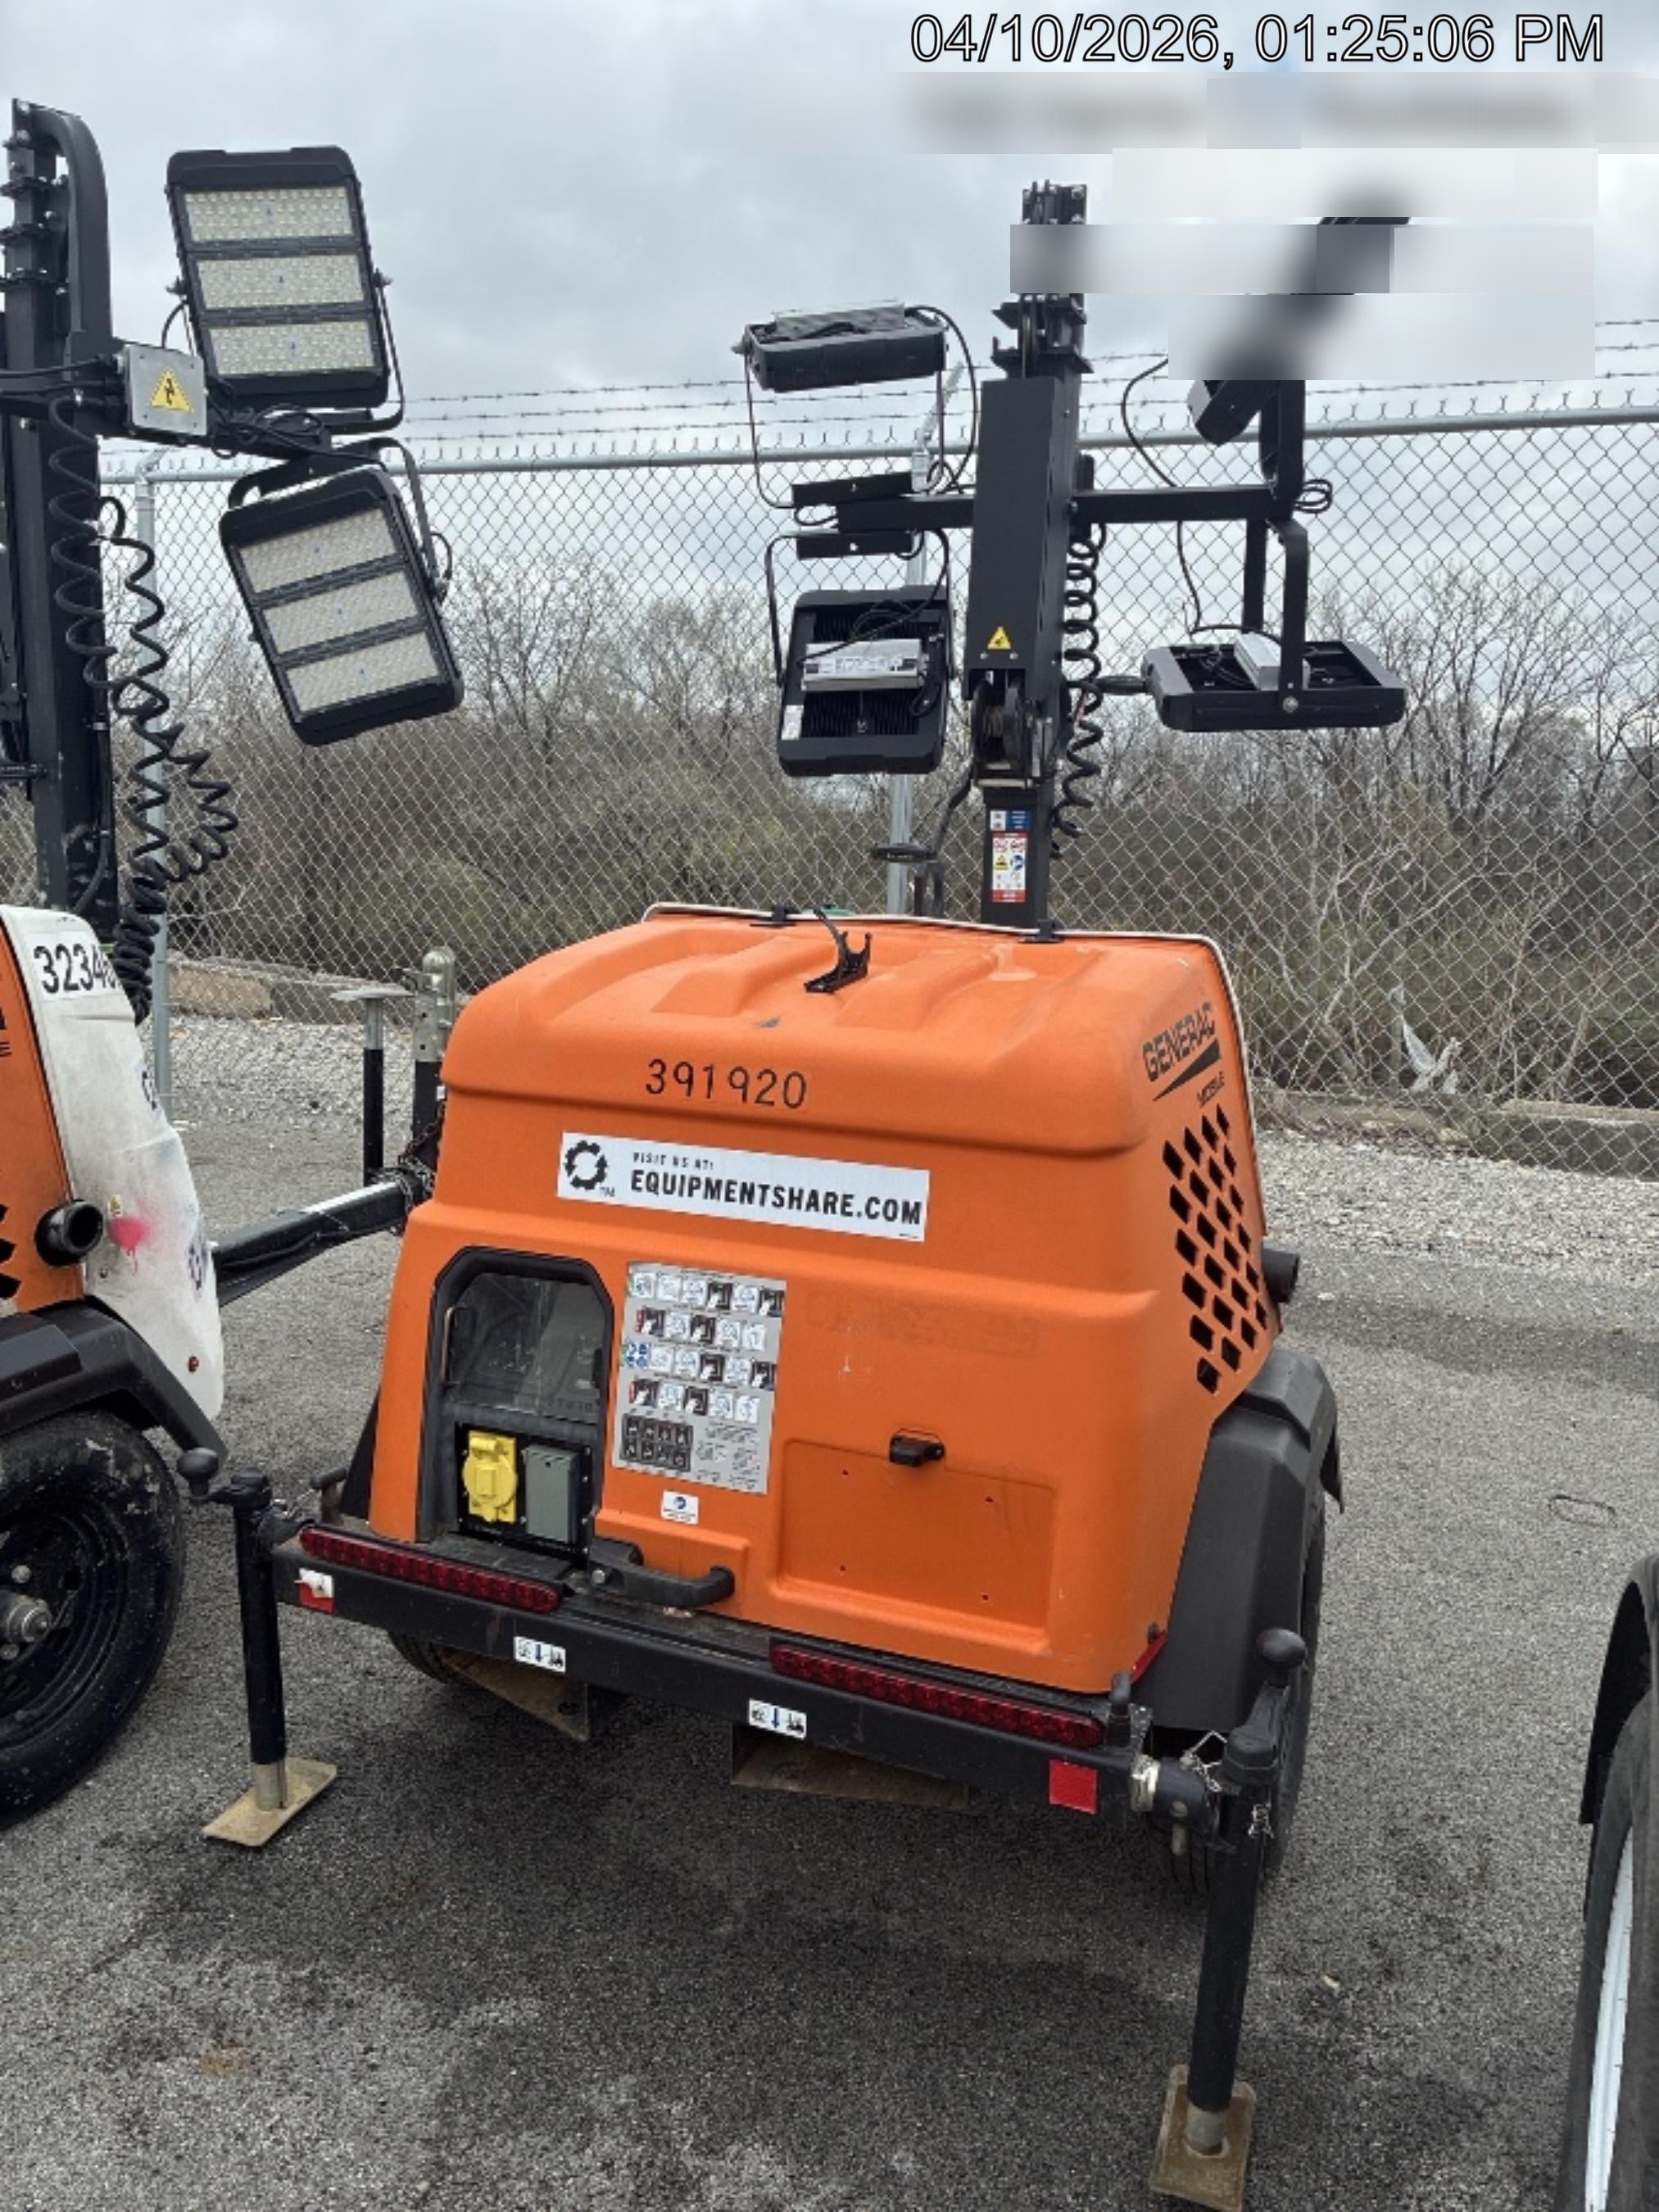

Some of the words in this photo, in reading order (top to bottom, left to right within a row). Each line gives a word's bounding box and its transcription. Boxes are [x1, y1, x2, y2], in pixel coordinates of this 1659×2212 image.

[1142, 1001, 1215, 1082] GENERAC
[646, 1058, 807, 1109] 391920
[630, 1169, 922, 1226] EQUIPMENTSHARE.COM
